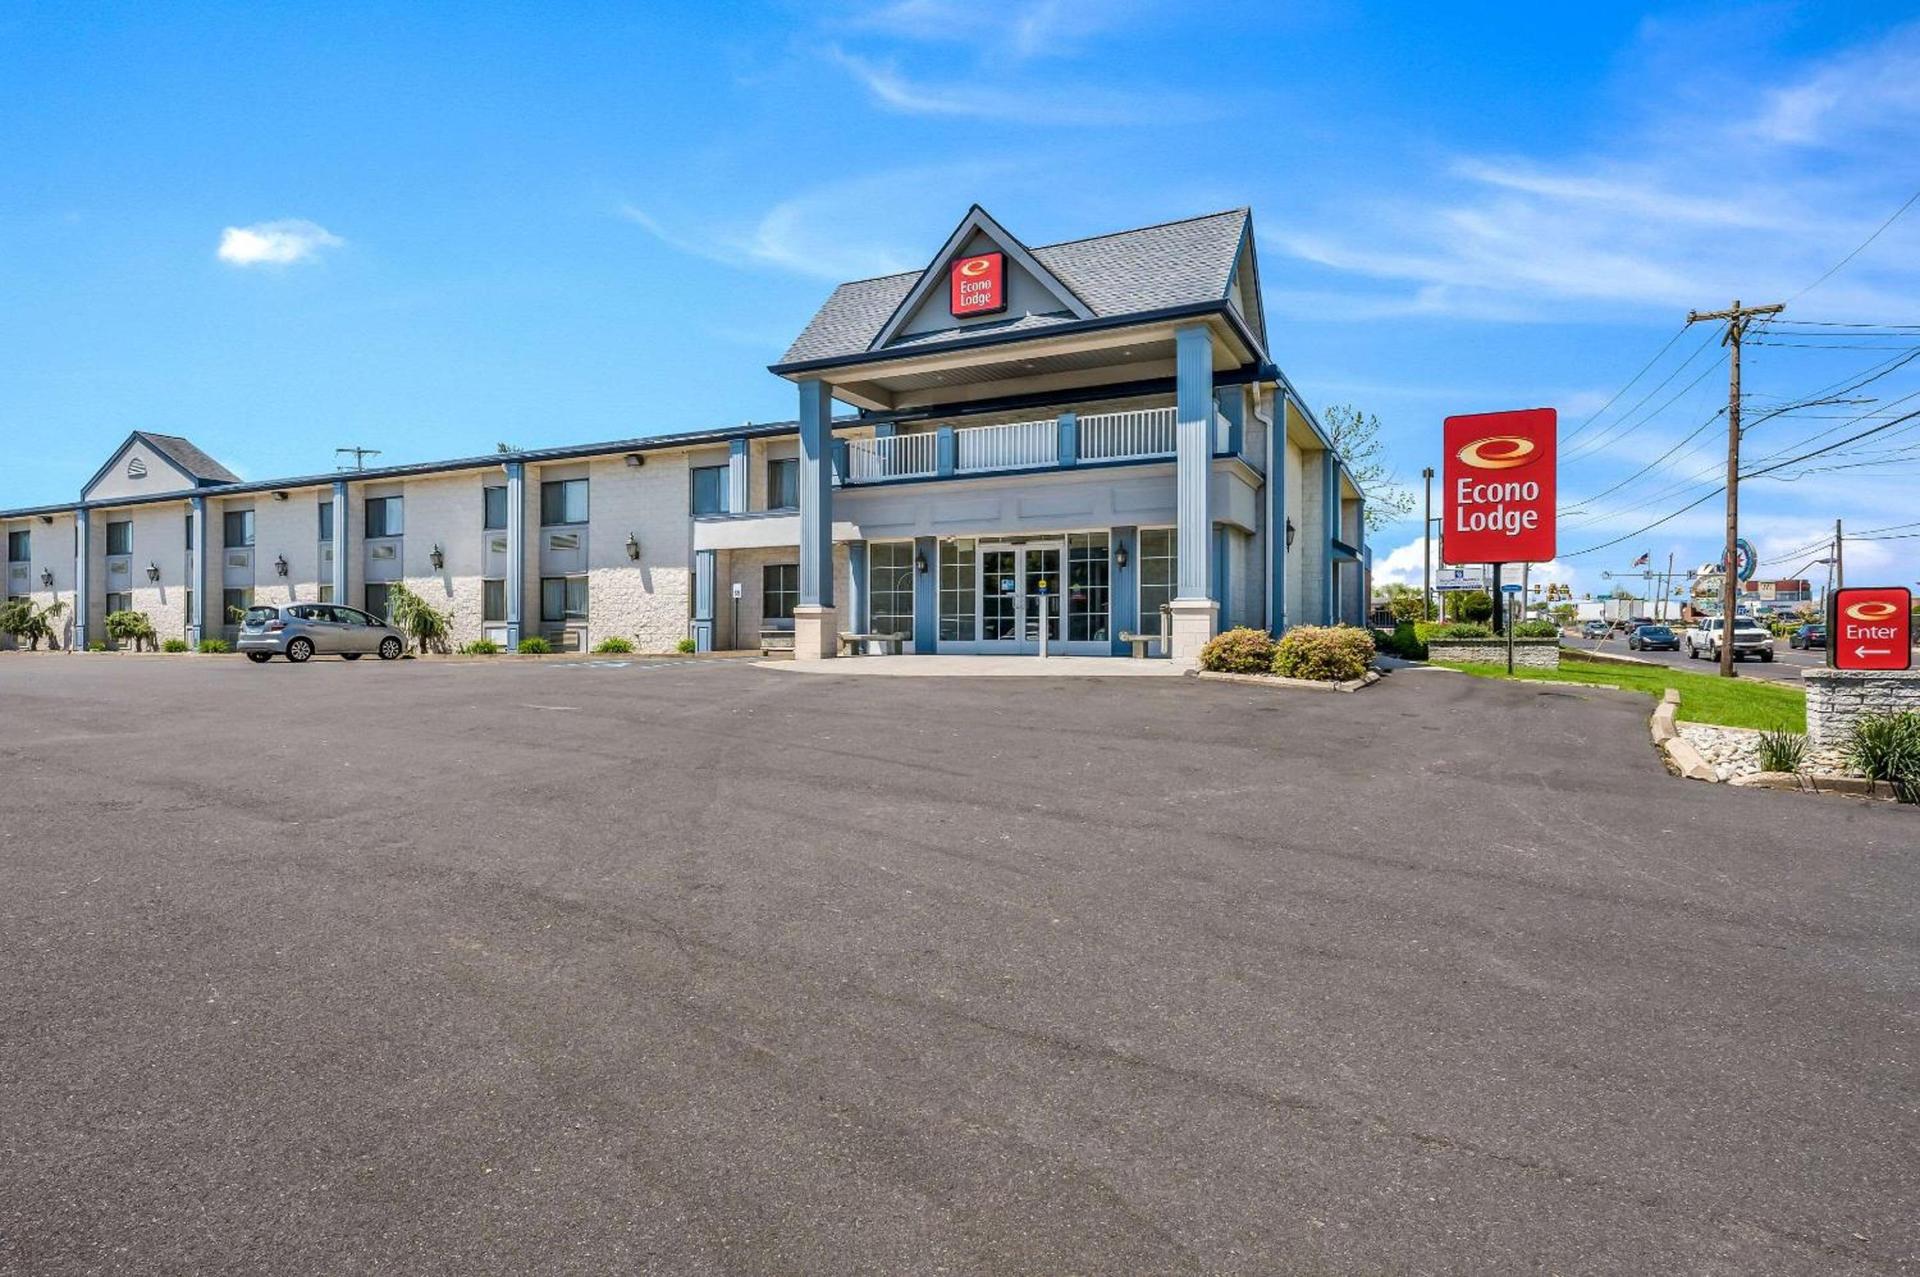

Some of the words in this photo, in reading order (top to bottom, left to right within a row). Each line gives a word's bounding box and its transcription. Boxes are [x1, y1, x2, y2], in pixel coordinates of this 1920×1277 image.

[960, 280, 992, 293] Econo
[960, 292, 992, 306] Lodge
[1457, 478, 1540, 503] Econo
[1457, 504, 1539, 536] Lodge
[1846, 624, 1898, 639] Enter
